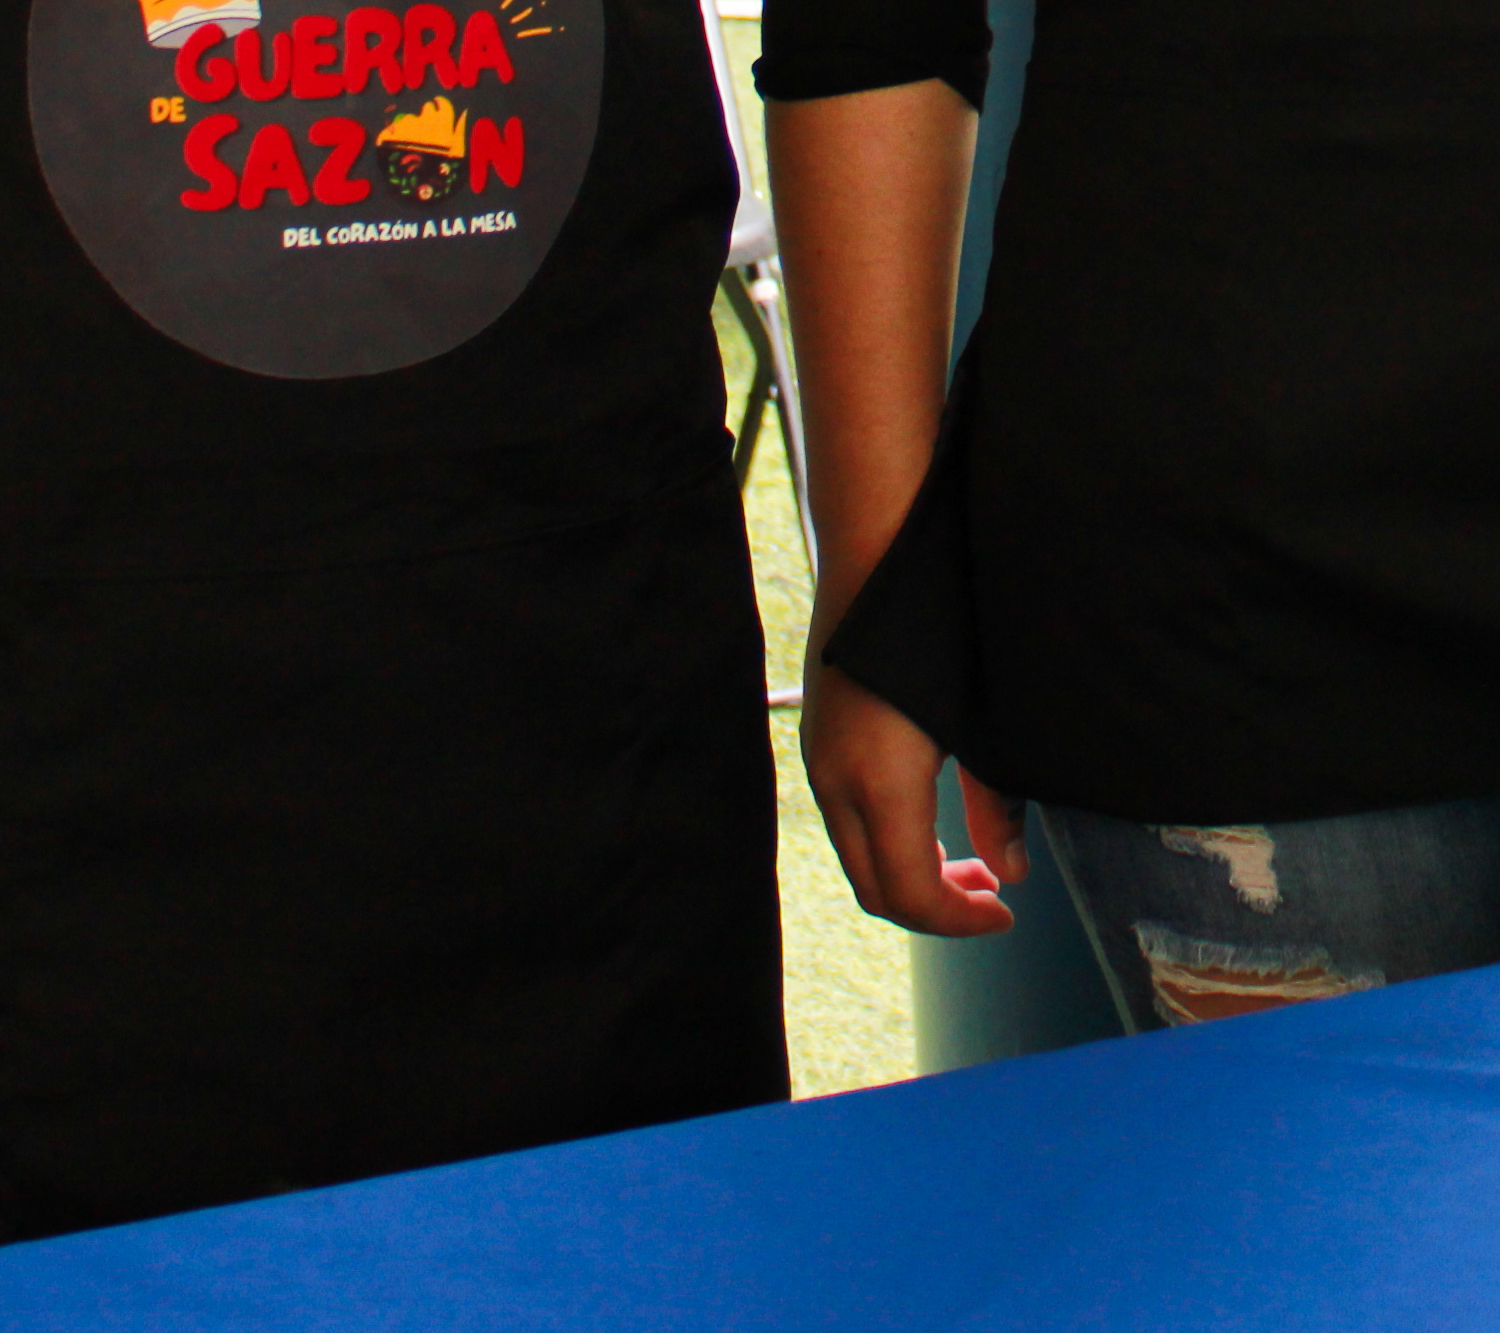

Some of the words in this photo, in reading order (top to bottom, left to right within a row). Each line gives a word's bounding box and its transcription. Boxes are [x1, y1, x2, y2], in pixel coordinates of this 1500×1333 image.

[174, 2, 516, 103] GUERRA
[150, 96, 187, 123] DE
[283, 227, 322, 249] DEL
[422, 219, 438, 238] A
[441, 218, 467, 237] LA
[470, 211, 517, 234] MESA
